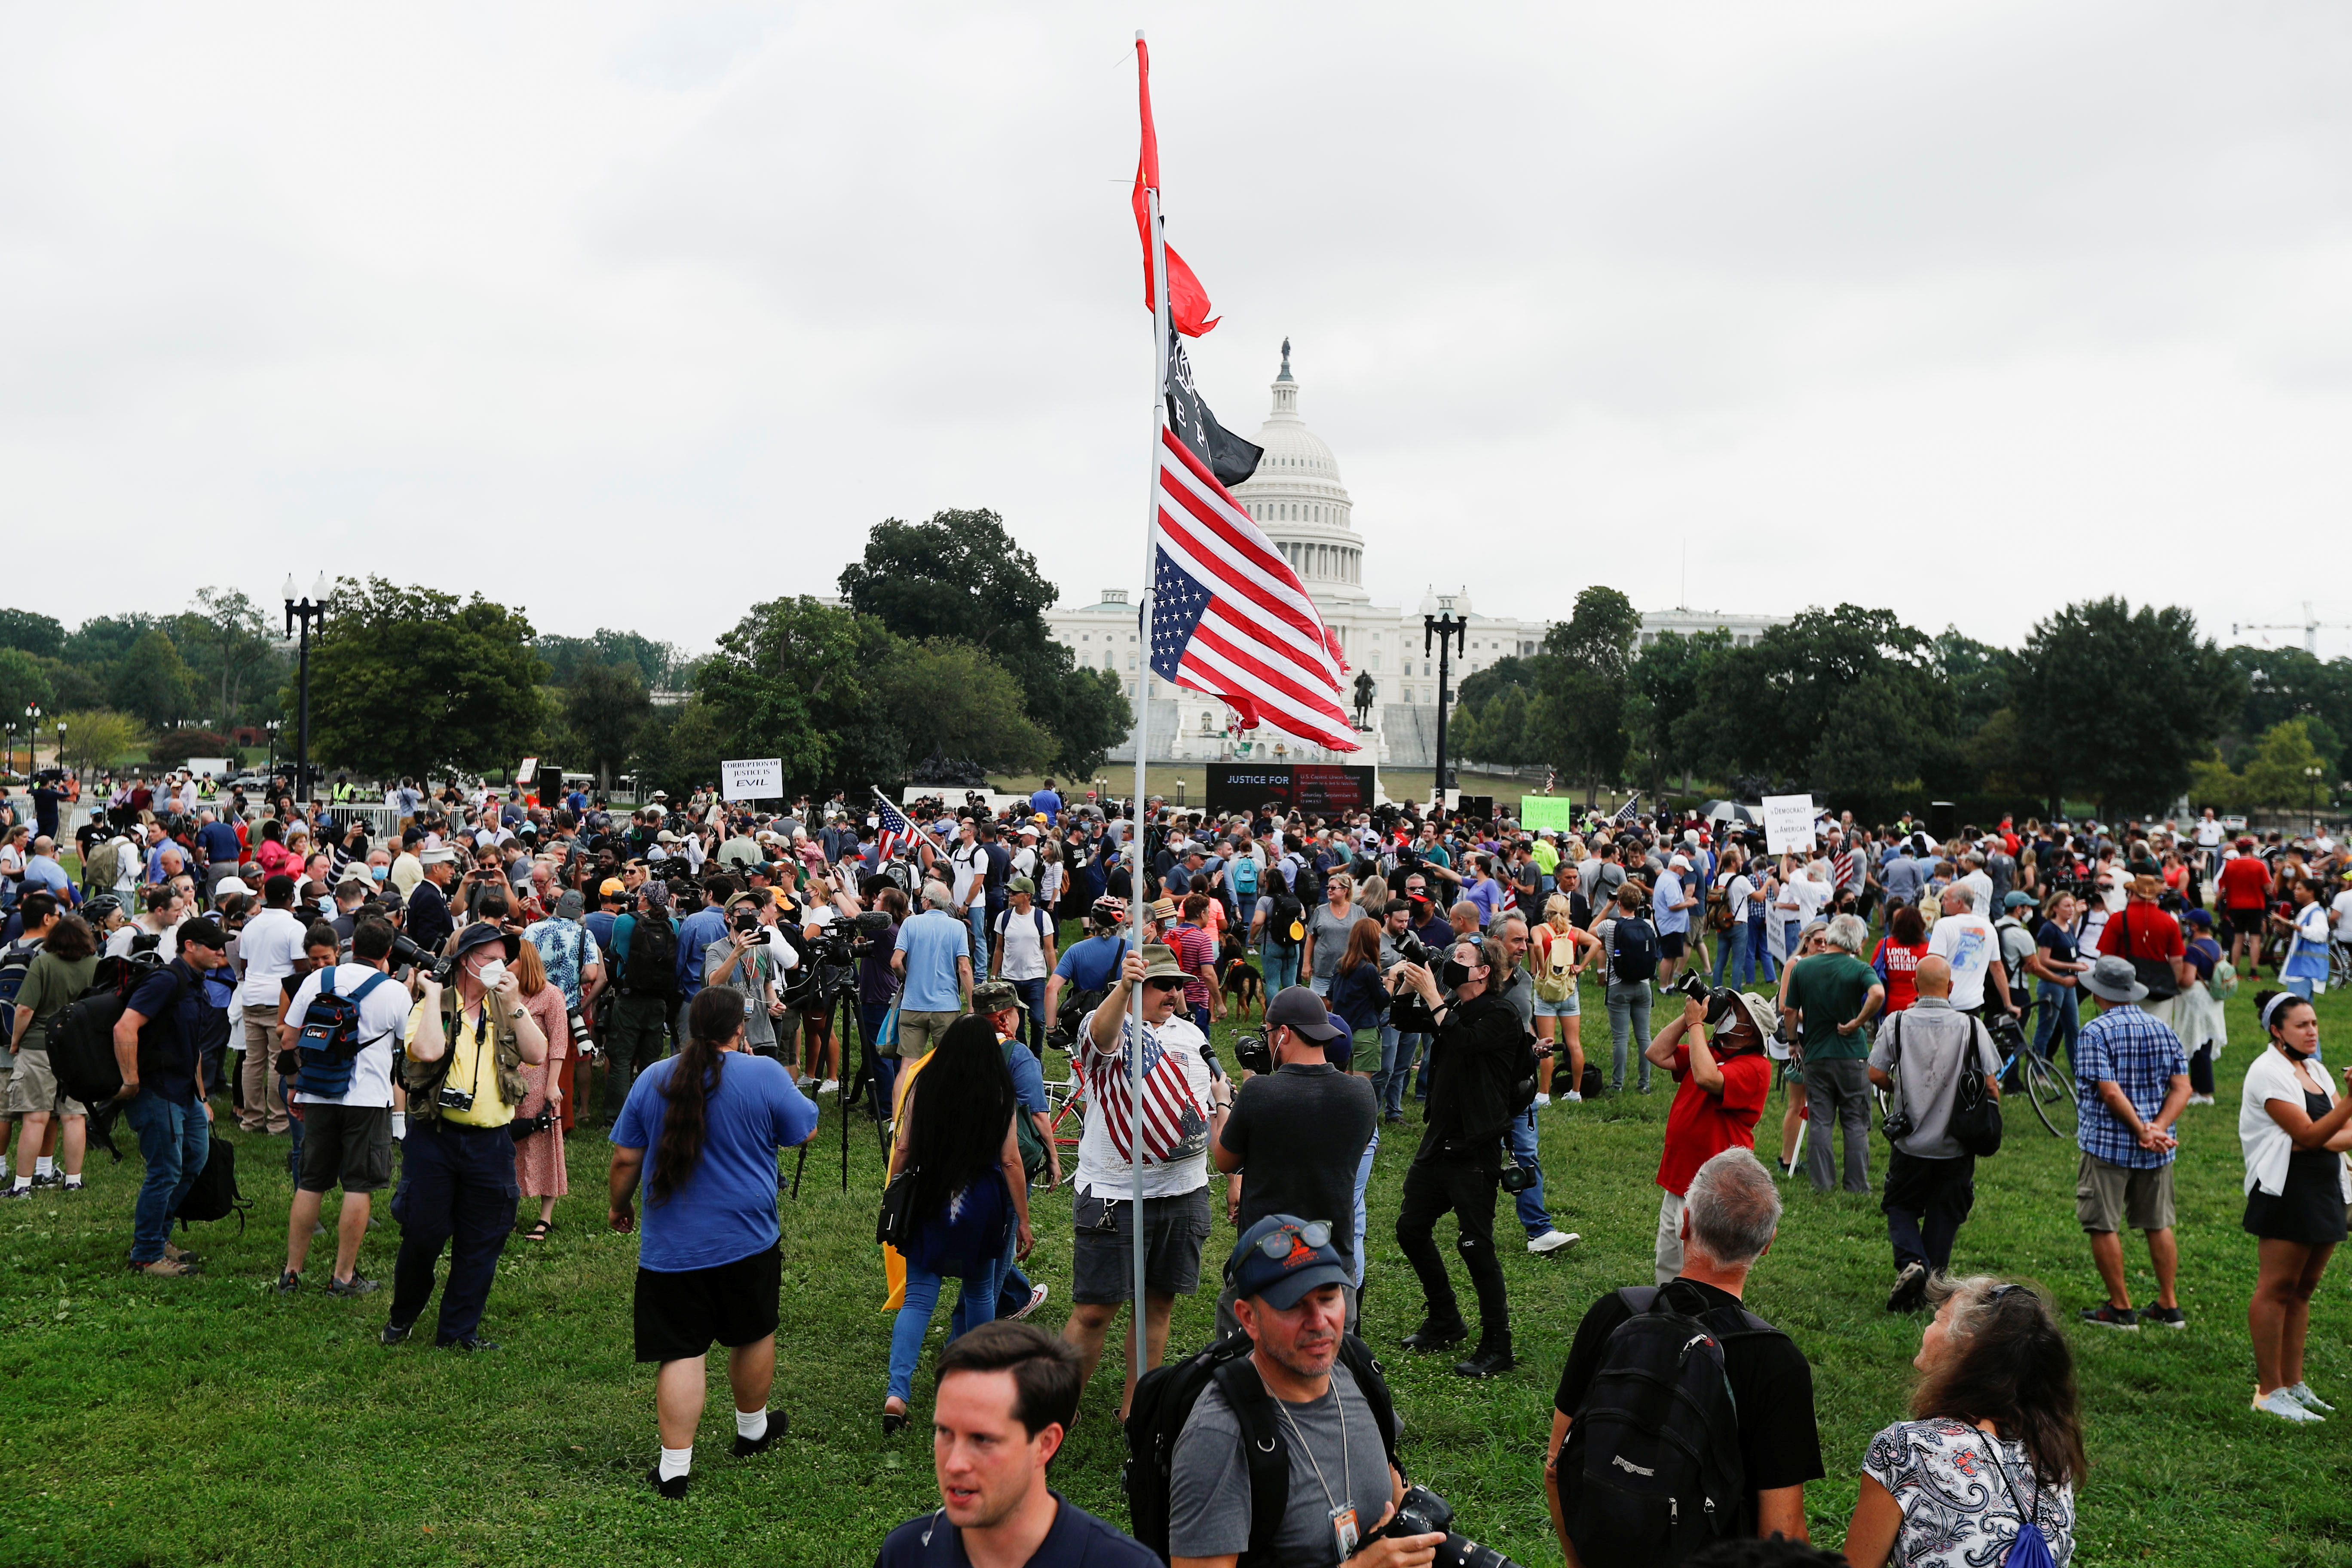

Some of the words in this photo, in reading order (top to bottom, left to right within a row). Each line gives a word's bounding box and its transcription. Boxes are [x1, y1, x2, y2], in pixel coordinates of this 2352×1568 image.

[736, 778, 769, 787] EVIL
[1227, 775, 1266, 784] JUSTICE
[1269, 776, 1289, 784] FOR
[1525, 801, 1539, 809] BLM
[1774, 807, 1806, 815] DEMOCRACY
[1530, 811, 1543, 820] Not
[1548, 812, 1564, 821] Even
[1886, 947, 1911, 956] LOOK
[1887, 955, 1918, 964] AHEAD
[1888, 963, 1916, 971] AMERI
[307, 1028, 328, 1039] LiveU
[1612, 1455, 1654, 1476] JANSPORT
